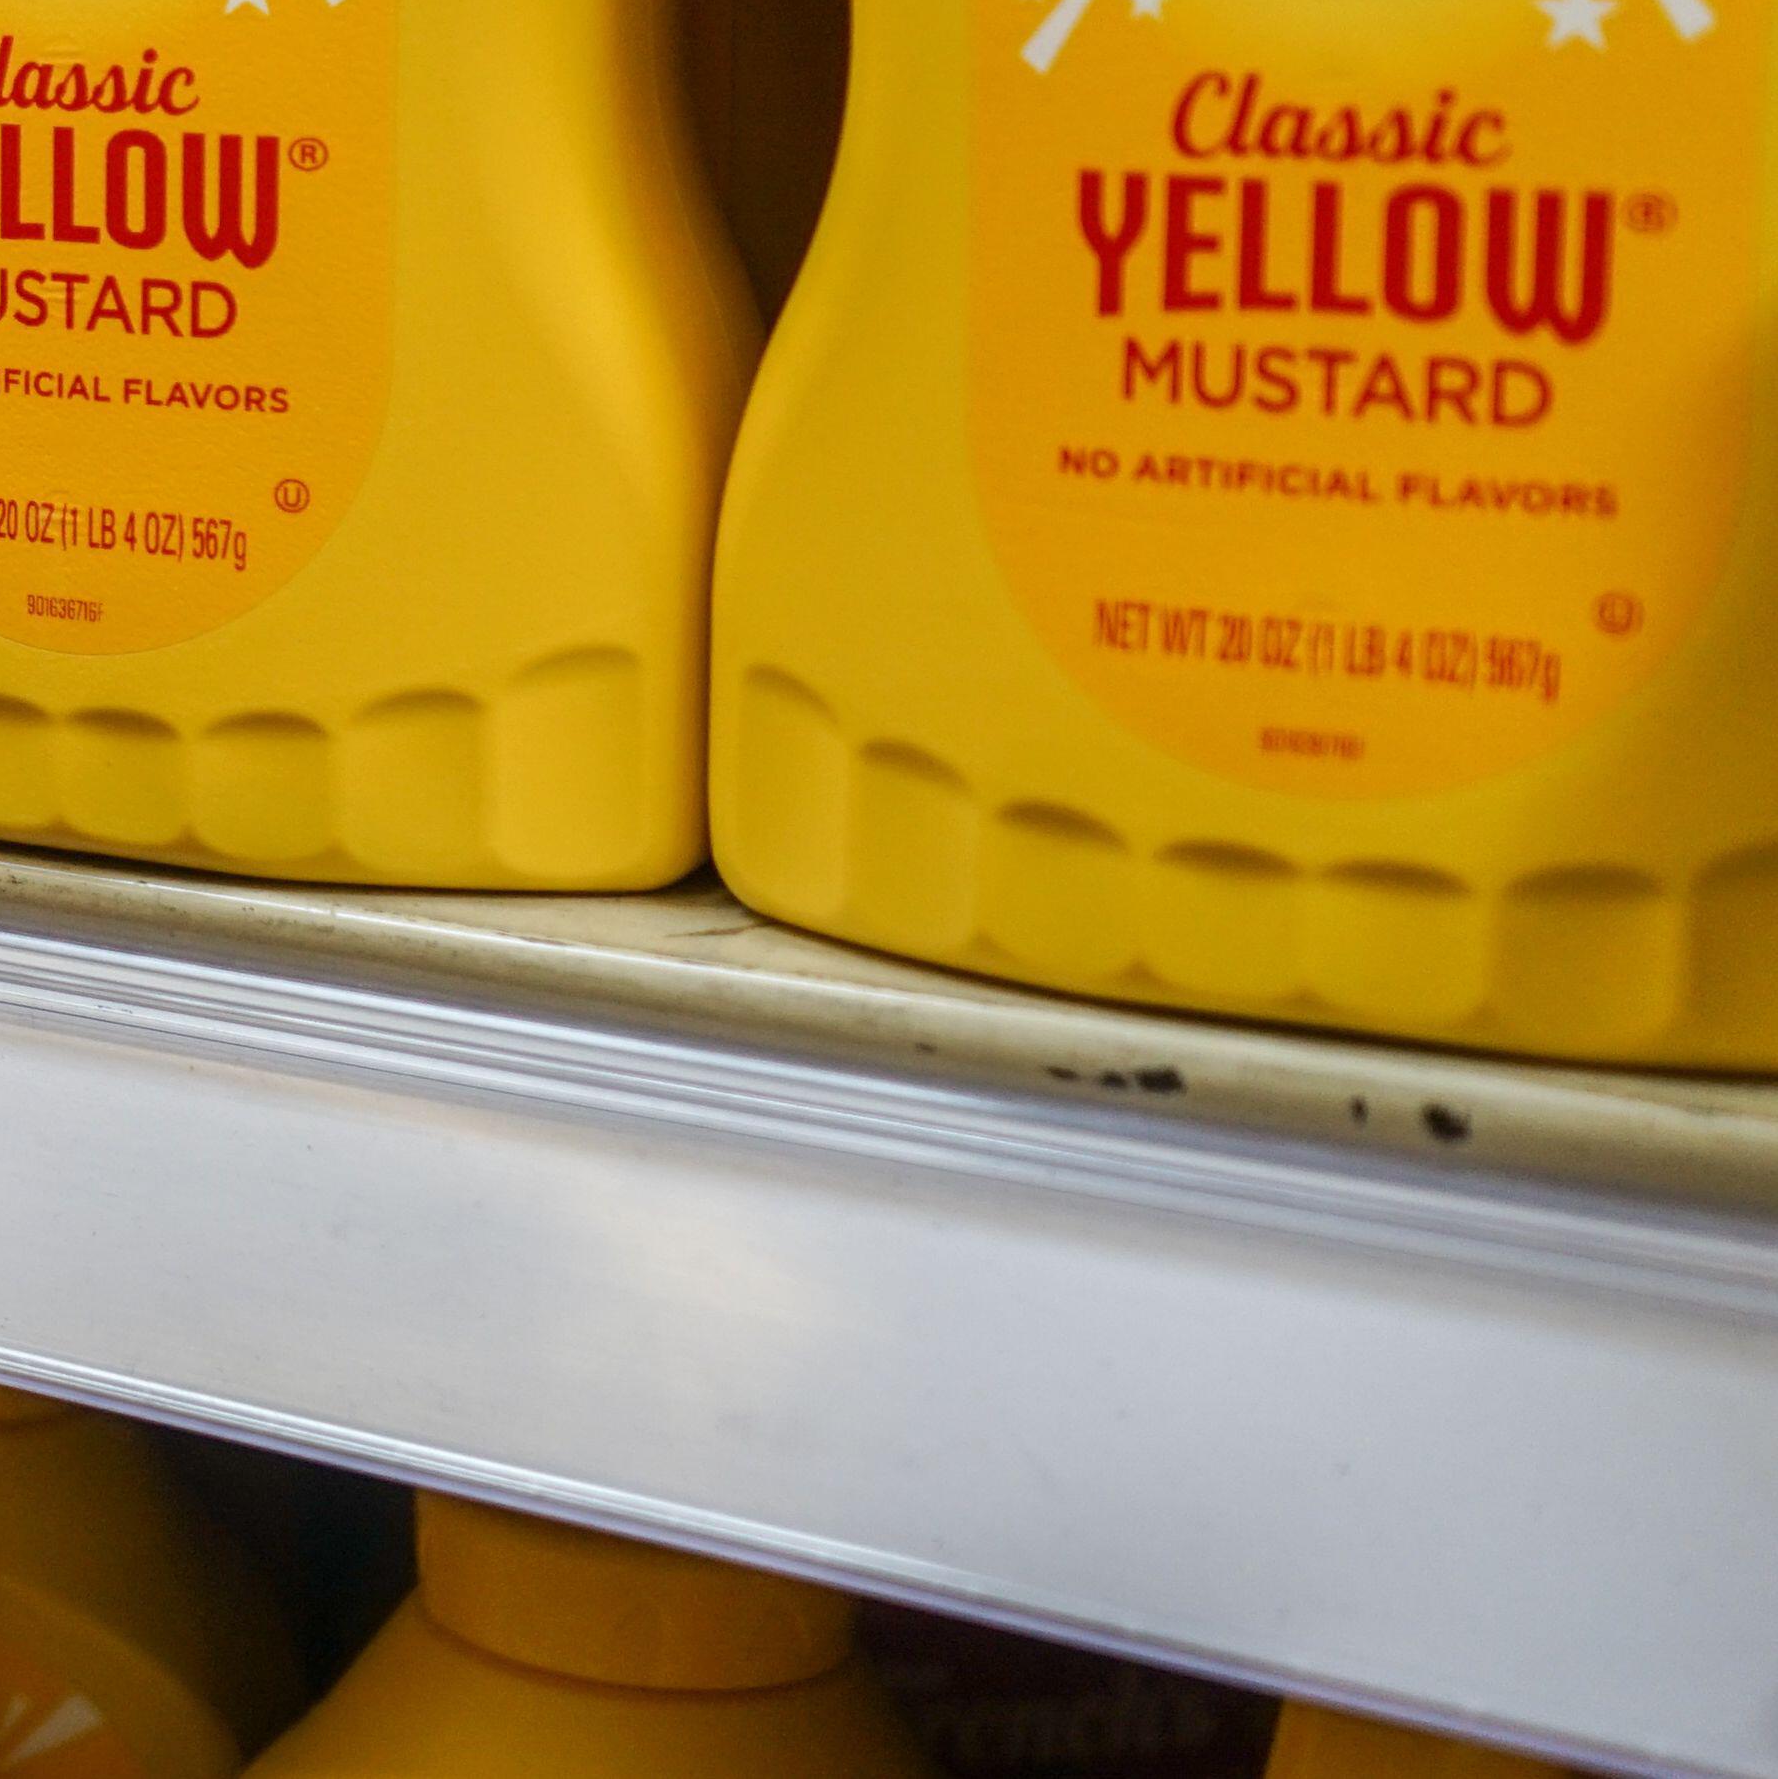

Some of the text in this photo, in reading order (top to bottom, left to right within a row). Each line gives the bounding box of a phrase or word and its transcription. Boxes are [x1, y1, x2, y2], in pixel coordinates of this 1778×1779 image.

[1168, 69, 1511, 168] Classic
[122, 377, 291, 416] FLAVORS
[1118, 335, 1558, 430] MUSTARD
[1058, 444, 1620, 522] NO ARTIFICIAL FLAVORS
[24, 499, 56, 545] OZ
[60, 502, 80, 552] (1
[87, 506, 118, 551] LB
[123, 511, 138, 553] 4
[143, 510, 185, 563] OZ)
[191, 516, 249, 572] 567g
[1093, 597, 1151, 654] NET
[1157, 606, 1212, 660] WT
